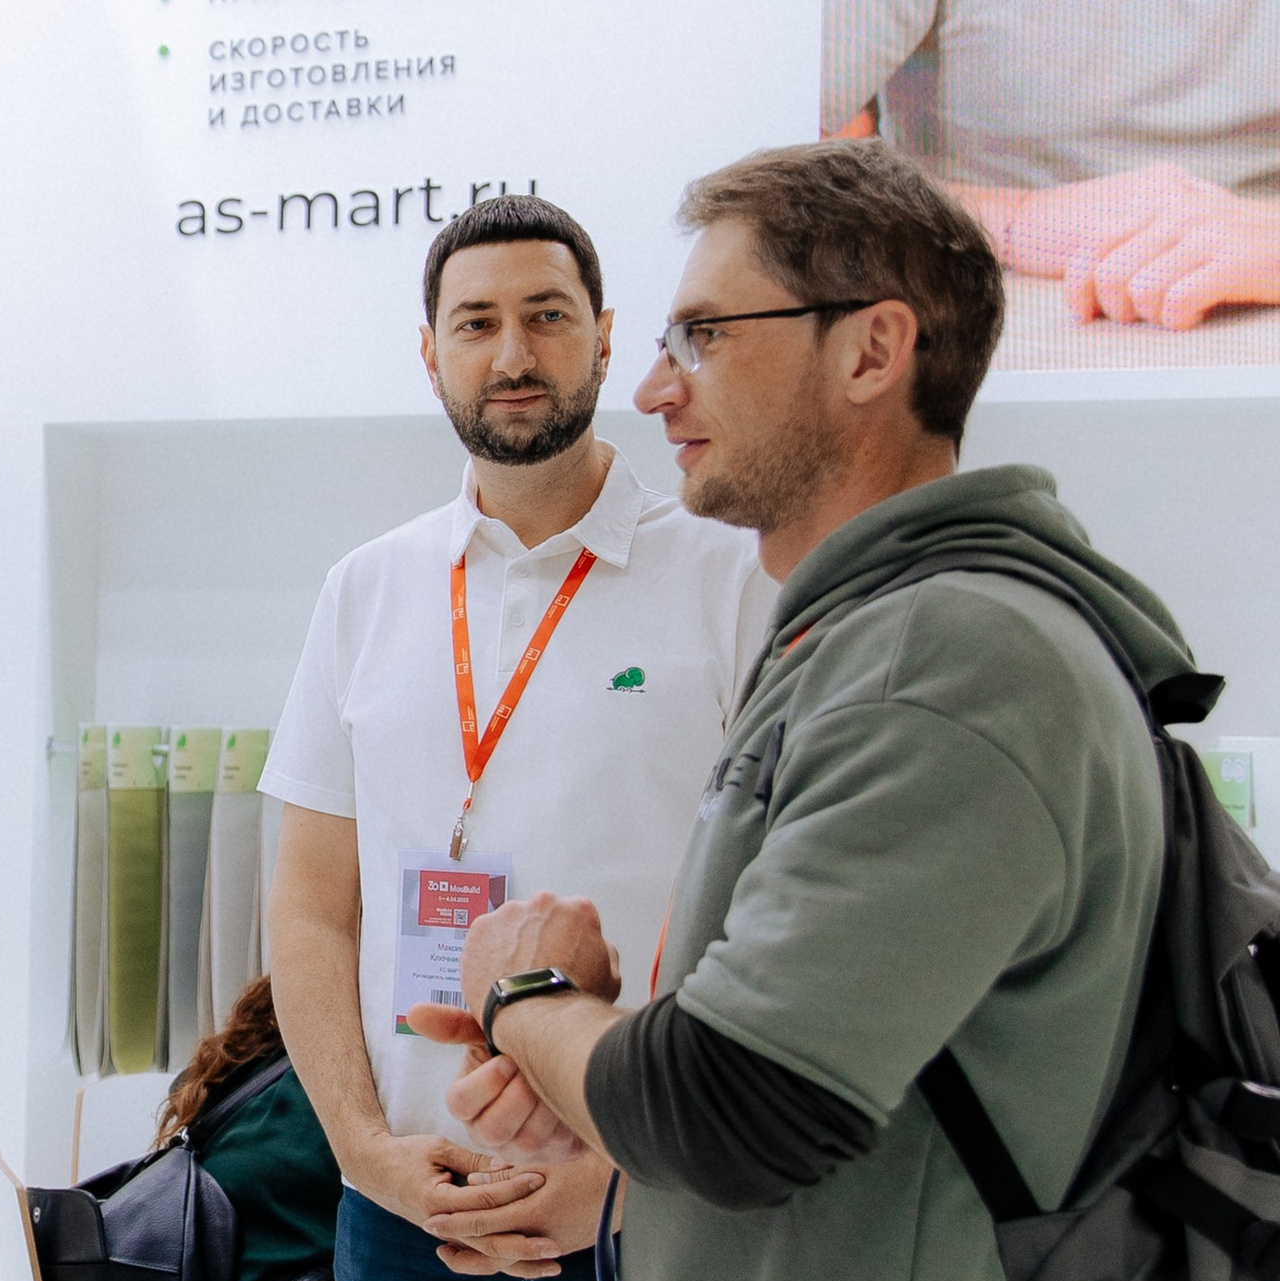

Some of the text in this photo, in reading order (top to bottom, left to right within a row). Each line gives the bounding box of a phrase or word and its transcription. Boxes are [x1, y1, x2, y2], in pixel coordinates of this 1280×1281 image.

[209, 29, 369, 61] СКОРОСТЬ
[209, 54, 457, 93] ИЗГОТОВЛЕНИЯ
[209, 95, 406, 128] И ДОСТАВКИ
[450, 884, 481, 894] MosBuild
